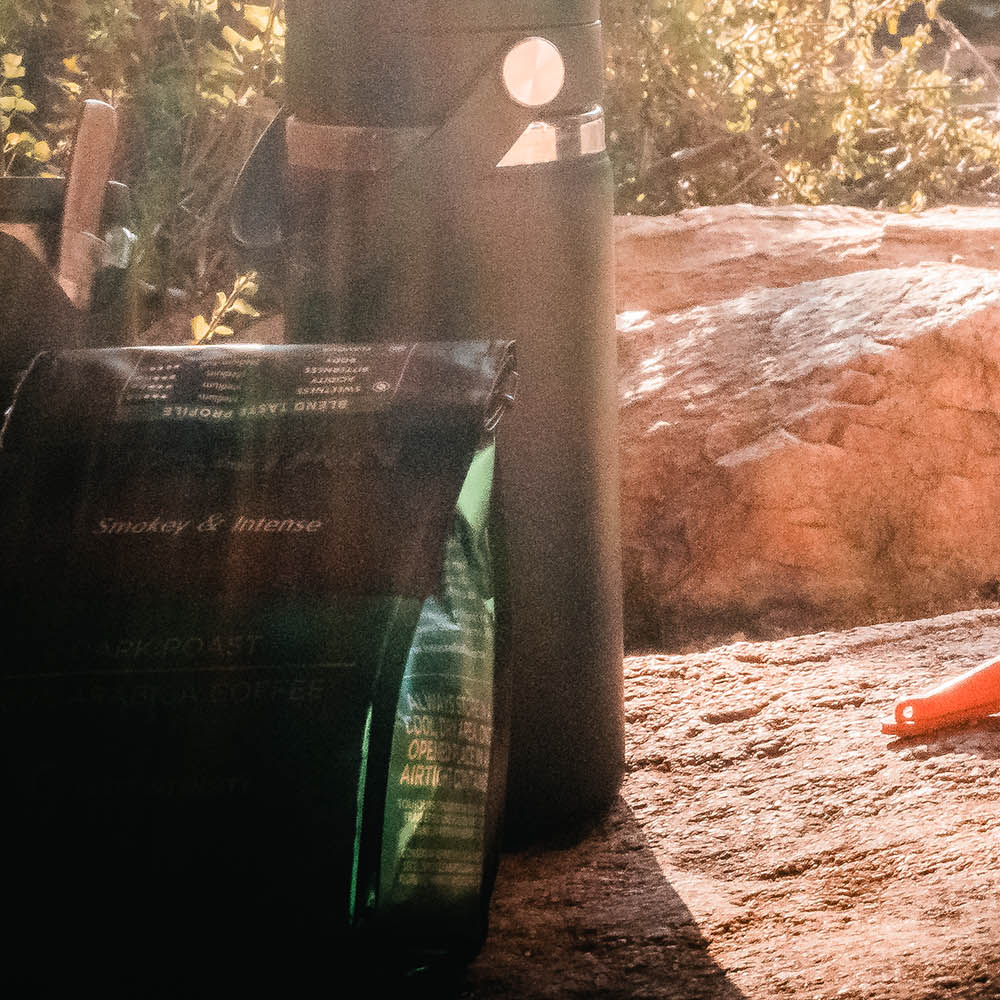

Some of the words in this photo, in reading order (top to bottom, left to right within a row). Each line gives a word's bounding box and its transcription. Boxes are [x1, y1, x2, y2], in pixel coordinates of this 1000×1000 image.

[162, 406, 234, 419] PROFILE
[294, 399, 348, 412] BLEND
[92, 516, 190, 537] Smokey
[197, 513, 226, 533] &
[231, 515, 324, 534] Intense
[160, 634, 264, 658] ROAST
[209, 679, 326, 703] COFFEE
